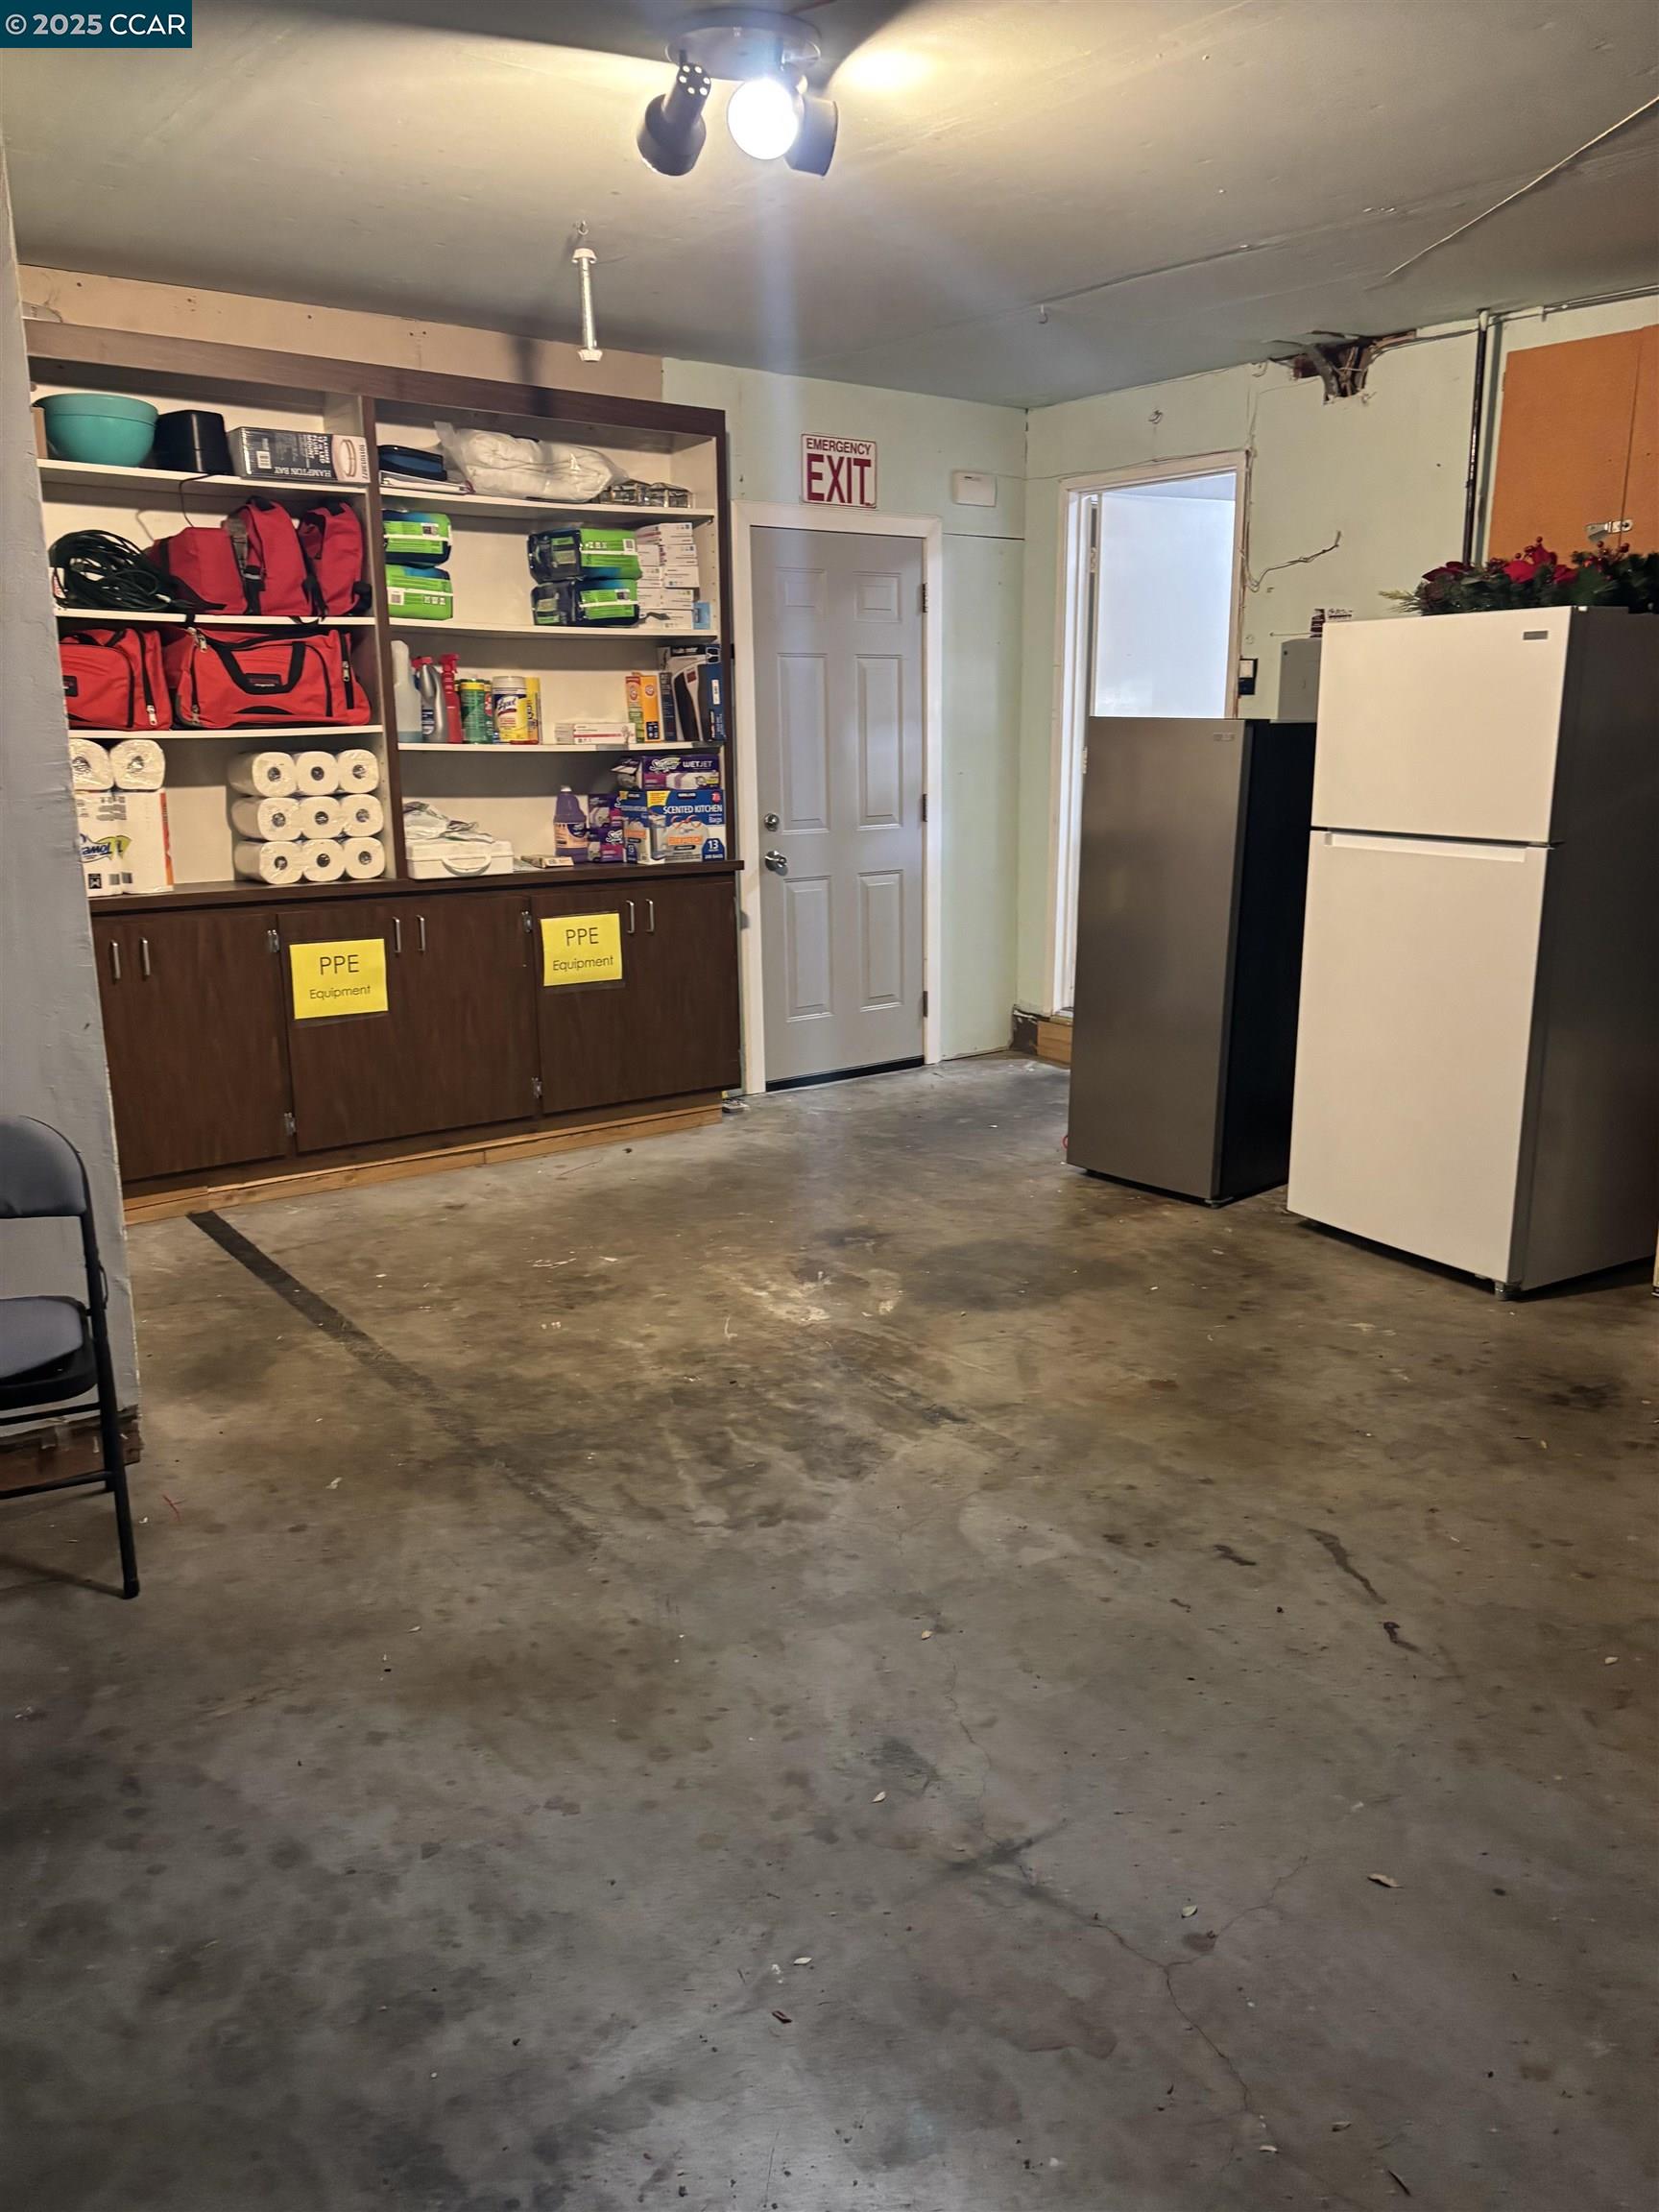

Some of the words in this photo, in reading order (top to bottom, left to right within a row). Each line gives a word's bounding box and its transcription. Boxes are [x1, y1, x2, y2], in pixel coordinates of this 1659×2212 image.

[805, 437, 872, 456] EMERGENCY
[806, 452, 872, 506] EXIT
[682, 759, 713, 769] WETJET
[662, 805, 693, 814] SCENTED
[694, 804, 723, 813] KITCHEN
[709, 839, 719, 849] 13
[565, 926, 599, 947] PPE
[319, 954, 360, 975] PPE
[552, 955, 614, 973] Equipment
[309, 984, 372, 1000] Equipment
